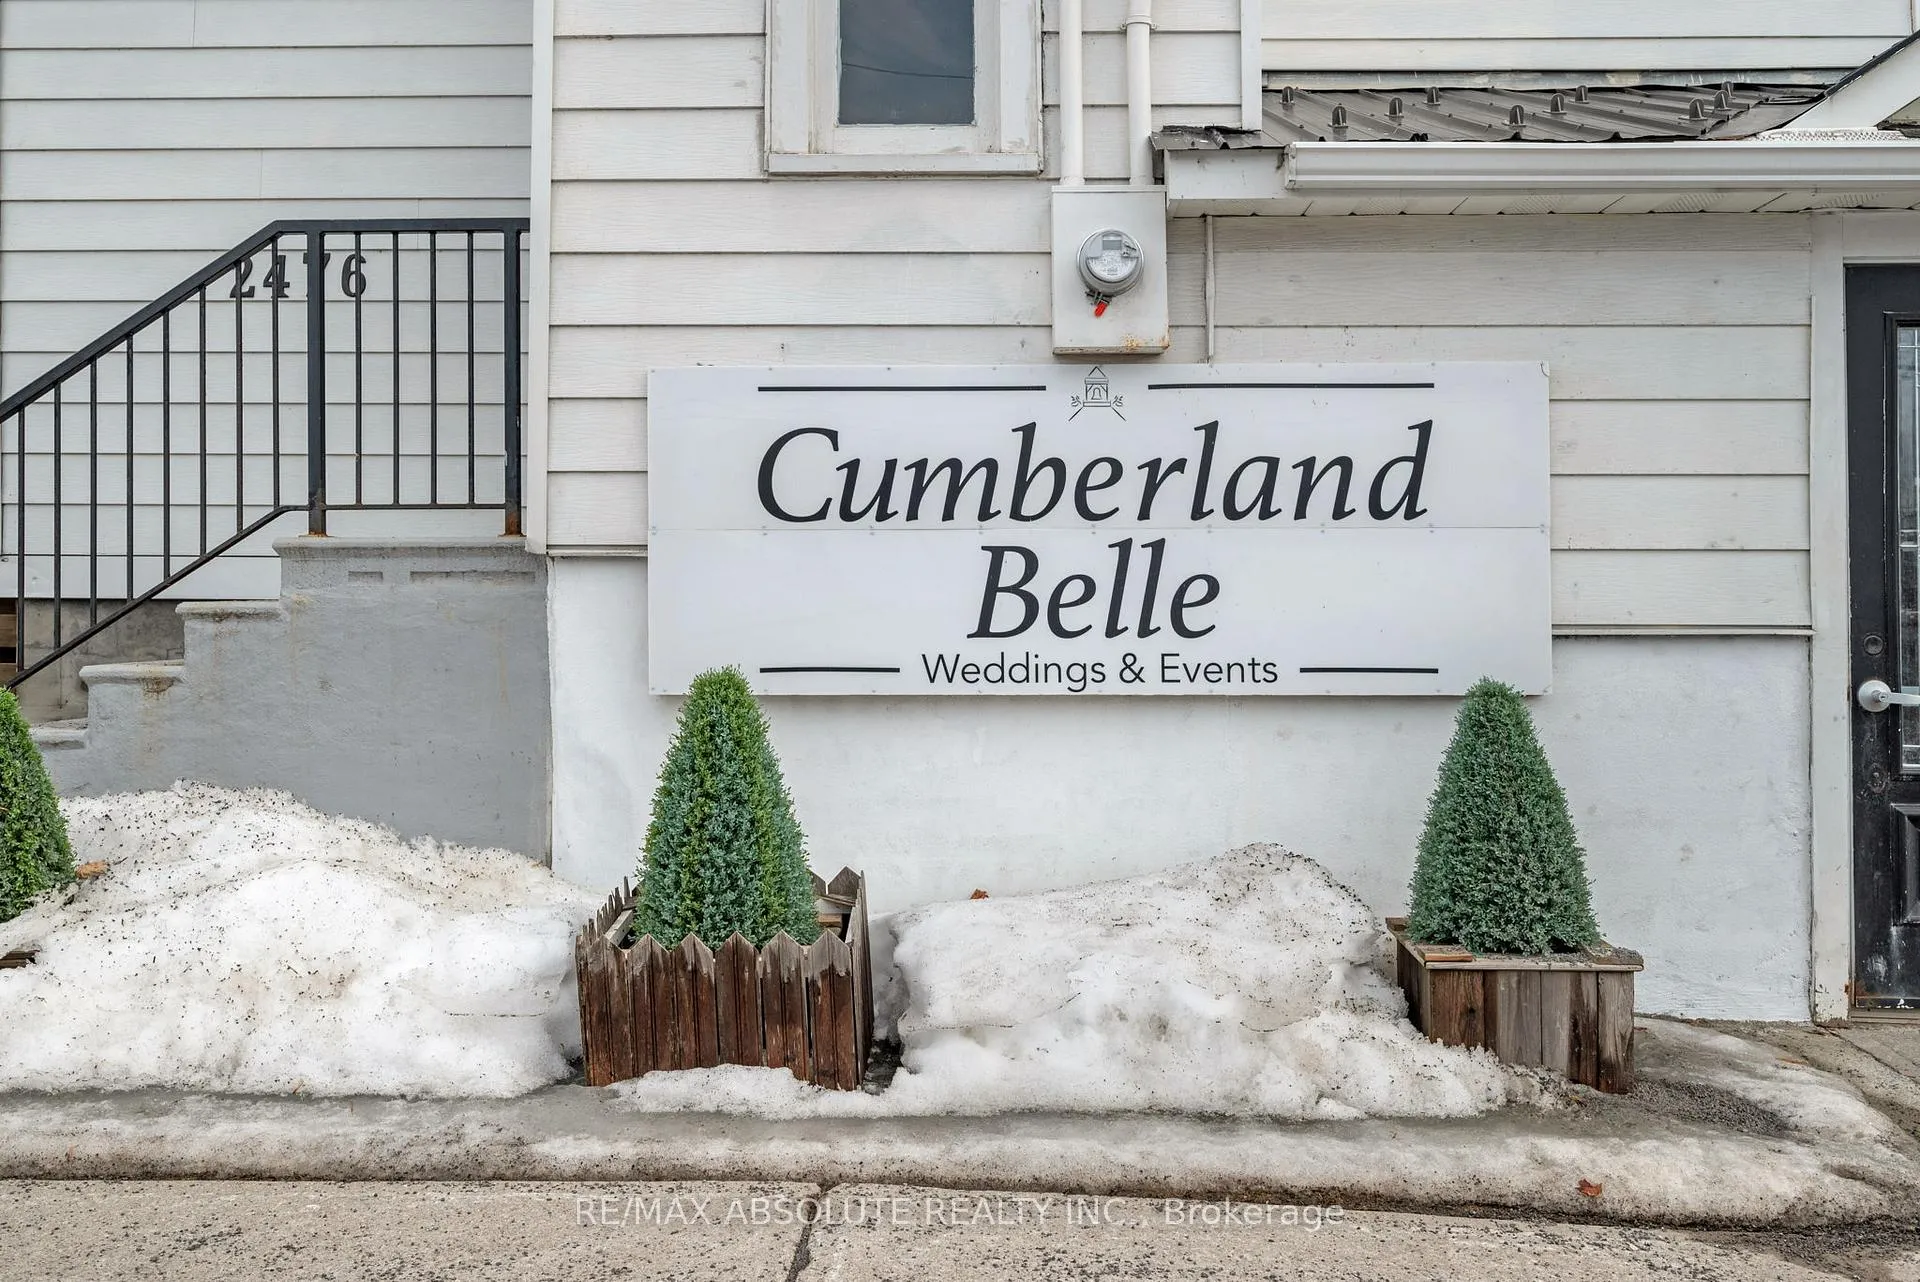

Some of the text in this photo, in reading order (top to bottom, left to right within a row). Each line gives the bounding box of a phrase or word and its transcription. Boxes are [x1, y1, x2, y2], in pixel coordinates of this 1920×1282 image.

[757, 419, 1433, 523] Cumberland
[967, 537, 1220, 639] Belle
[921, 652, 1278, 694] Weddings & Events
